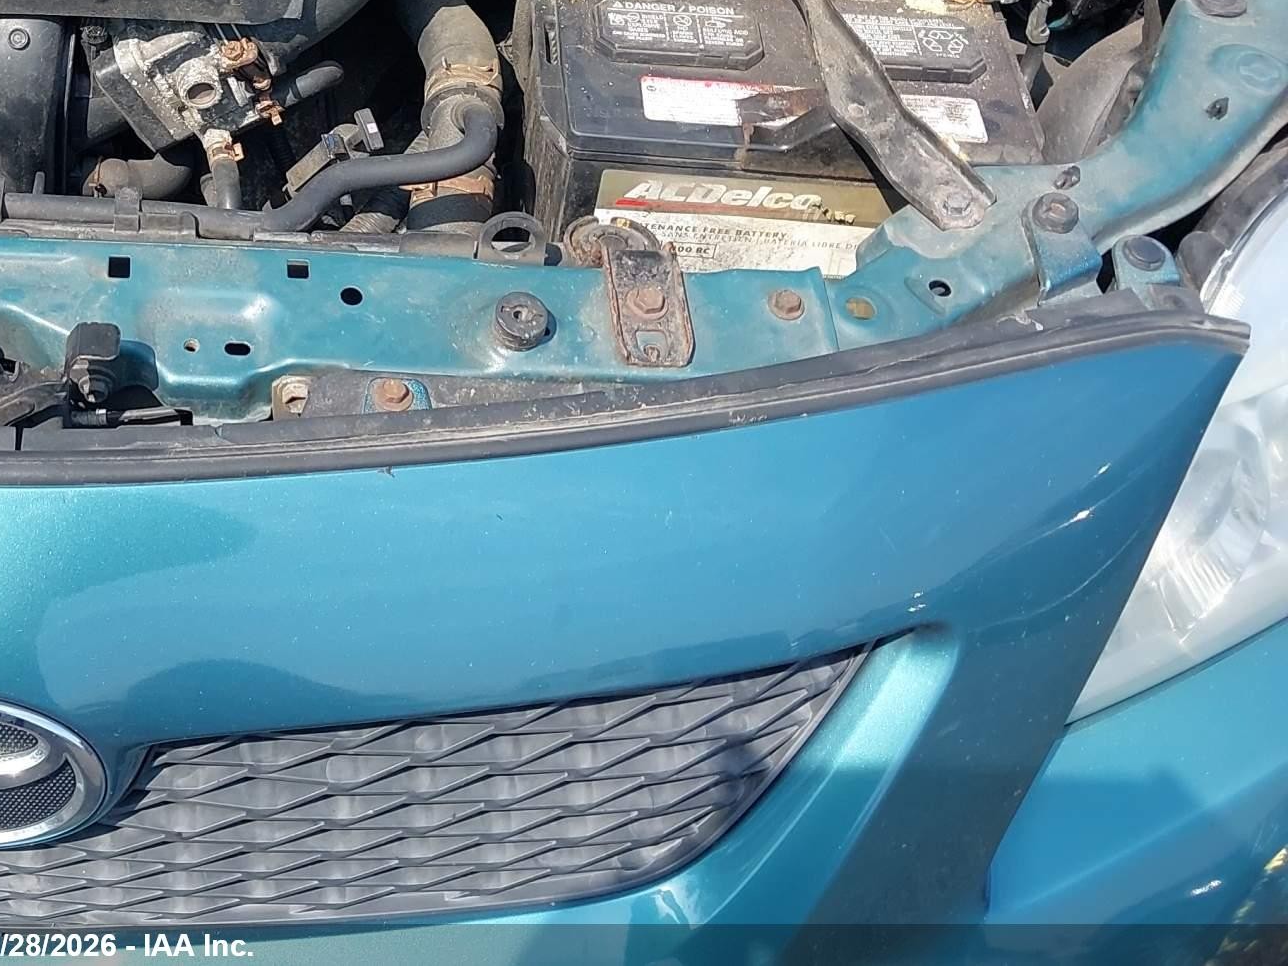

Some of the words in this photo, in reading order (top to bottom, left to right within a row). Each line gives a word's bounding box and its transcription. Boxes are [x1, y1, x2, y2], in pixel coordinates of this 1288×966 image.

[624, 1, 675, 12] DANGER
[689, 5, 735, 15] POISON
[623, 181, 822, 210] ACDelco
[702, 227, 730, 235] FREE
